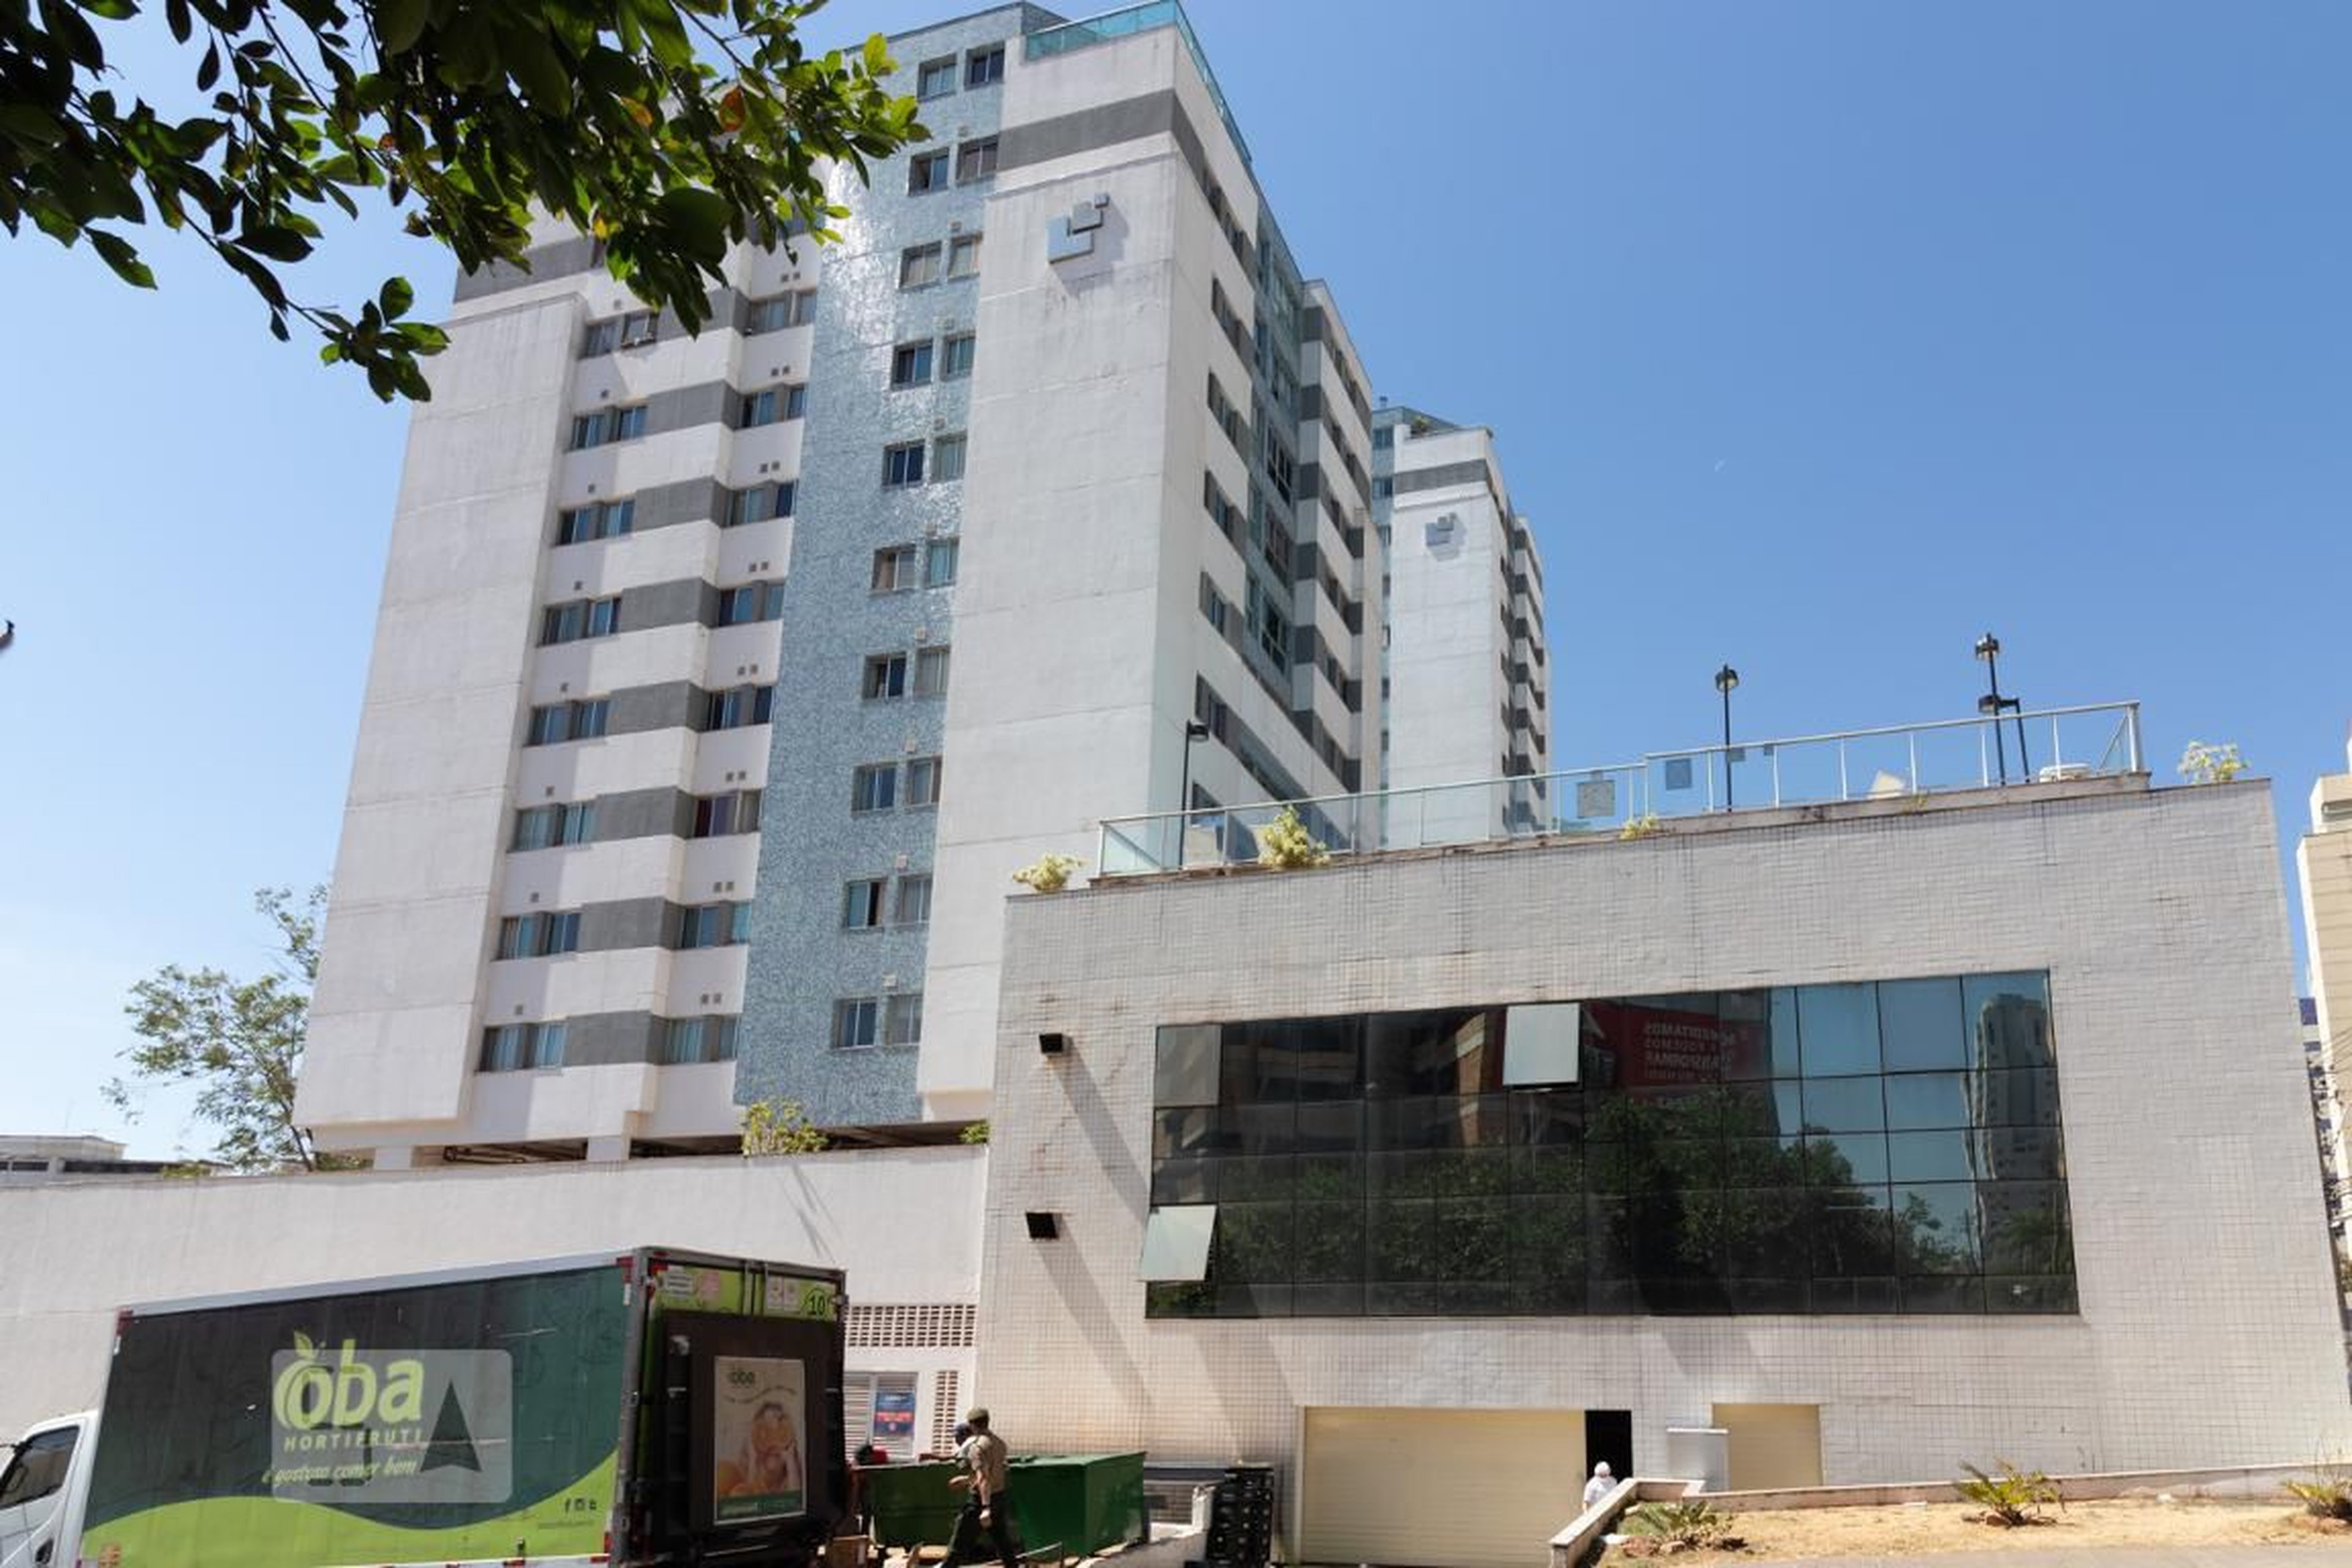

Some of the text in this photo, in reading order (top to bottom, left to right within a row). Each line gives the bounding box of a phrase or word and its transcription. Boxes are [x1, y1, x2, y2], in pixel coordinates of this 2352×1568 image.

[808, 1293, 825, 1316] 10
[273, 1338, 424, 1431] oba
[284, 1428, 422, 1452] HORTIFRUTI
